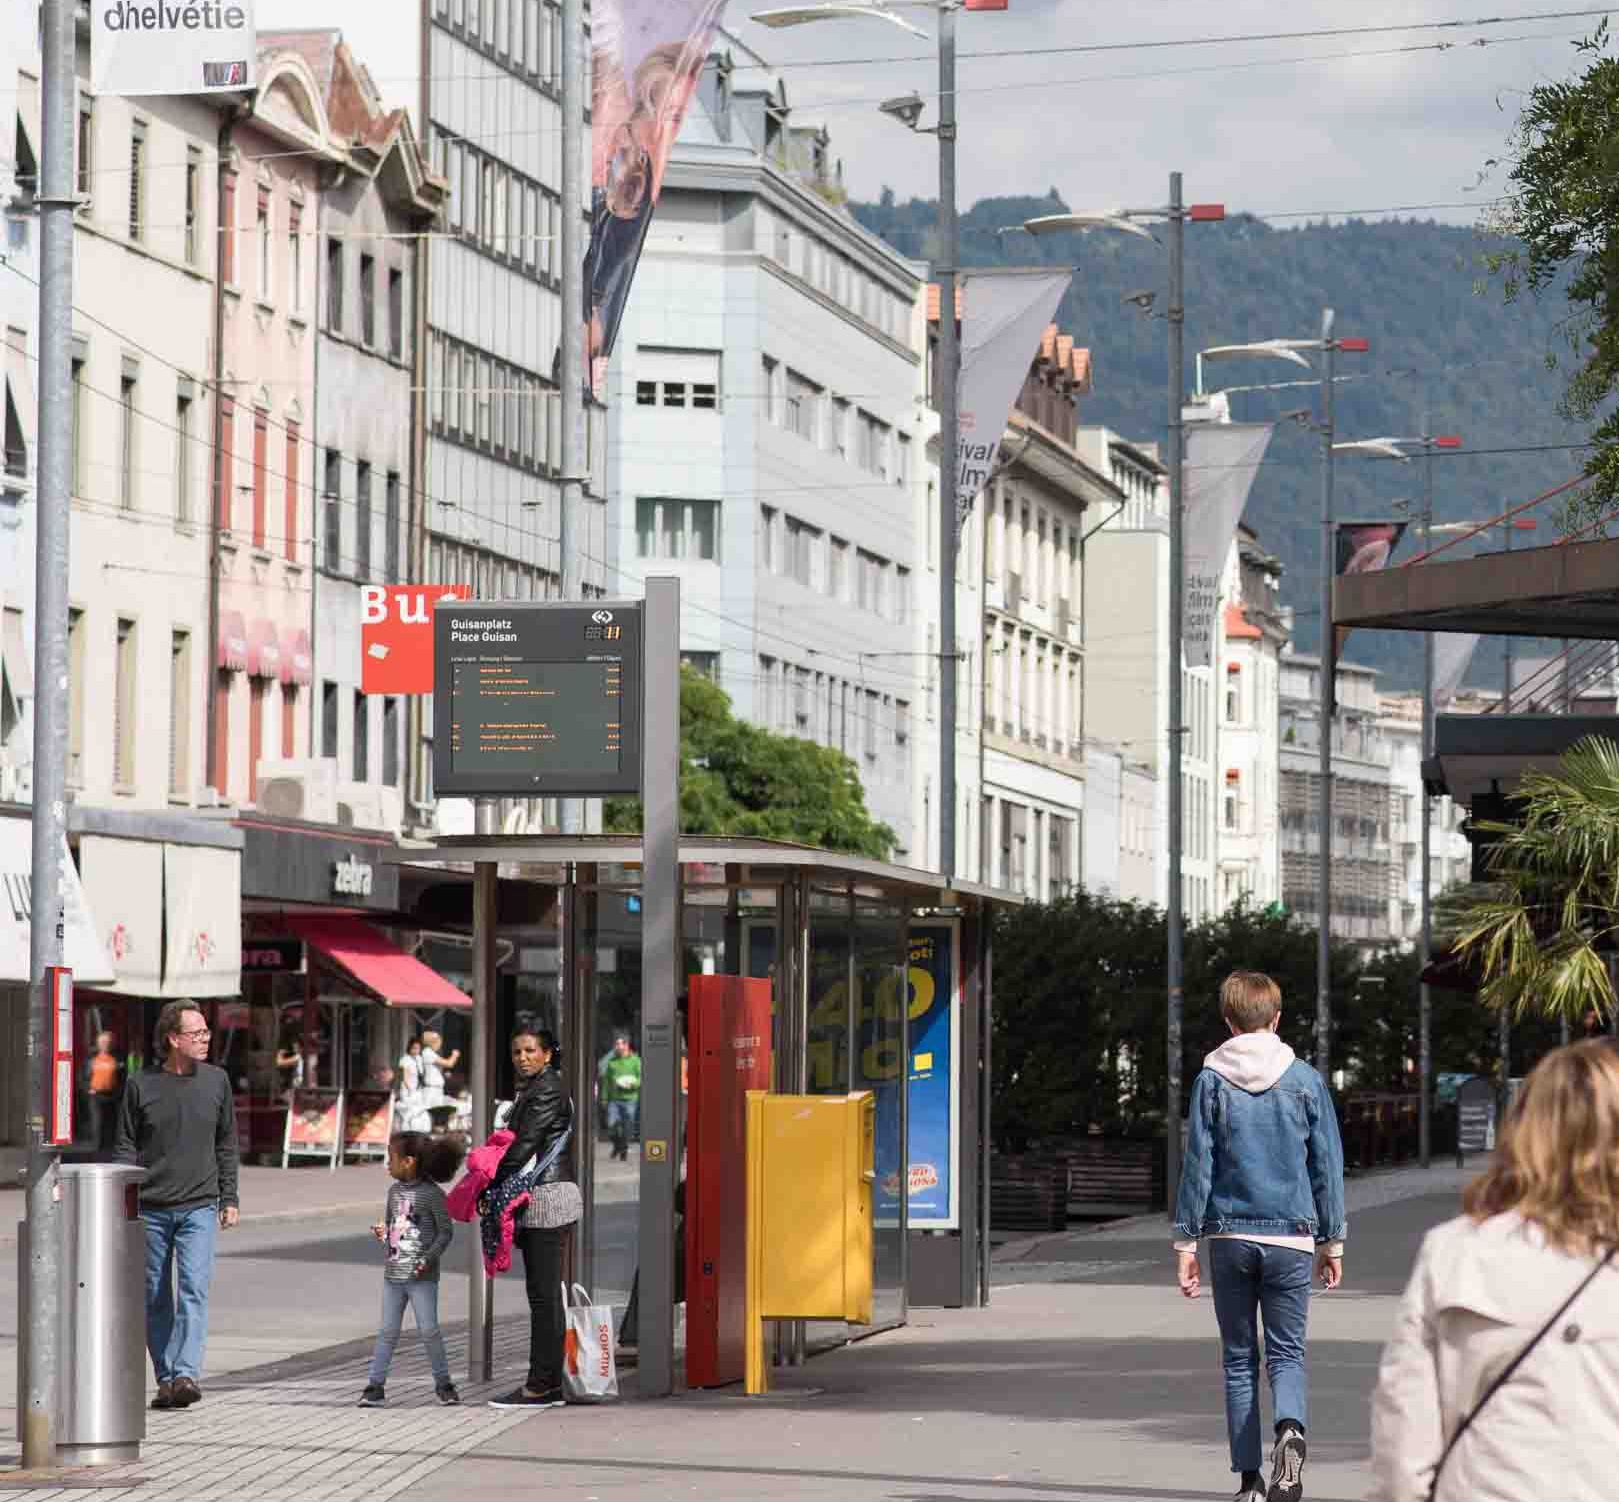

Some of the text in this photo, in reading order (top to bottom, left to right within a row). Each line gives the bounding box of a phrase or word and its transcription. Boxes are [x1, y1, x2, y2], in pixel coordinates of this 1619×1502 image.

[451, 619, 512, 631] Guisanplatz
[451, 632, 517, 642] Place Guisan
[335, 854, 373, 896] zebra
[599, 1323, 609, 1378] MIGROS
